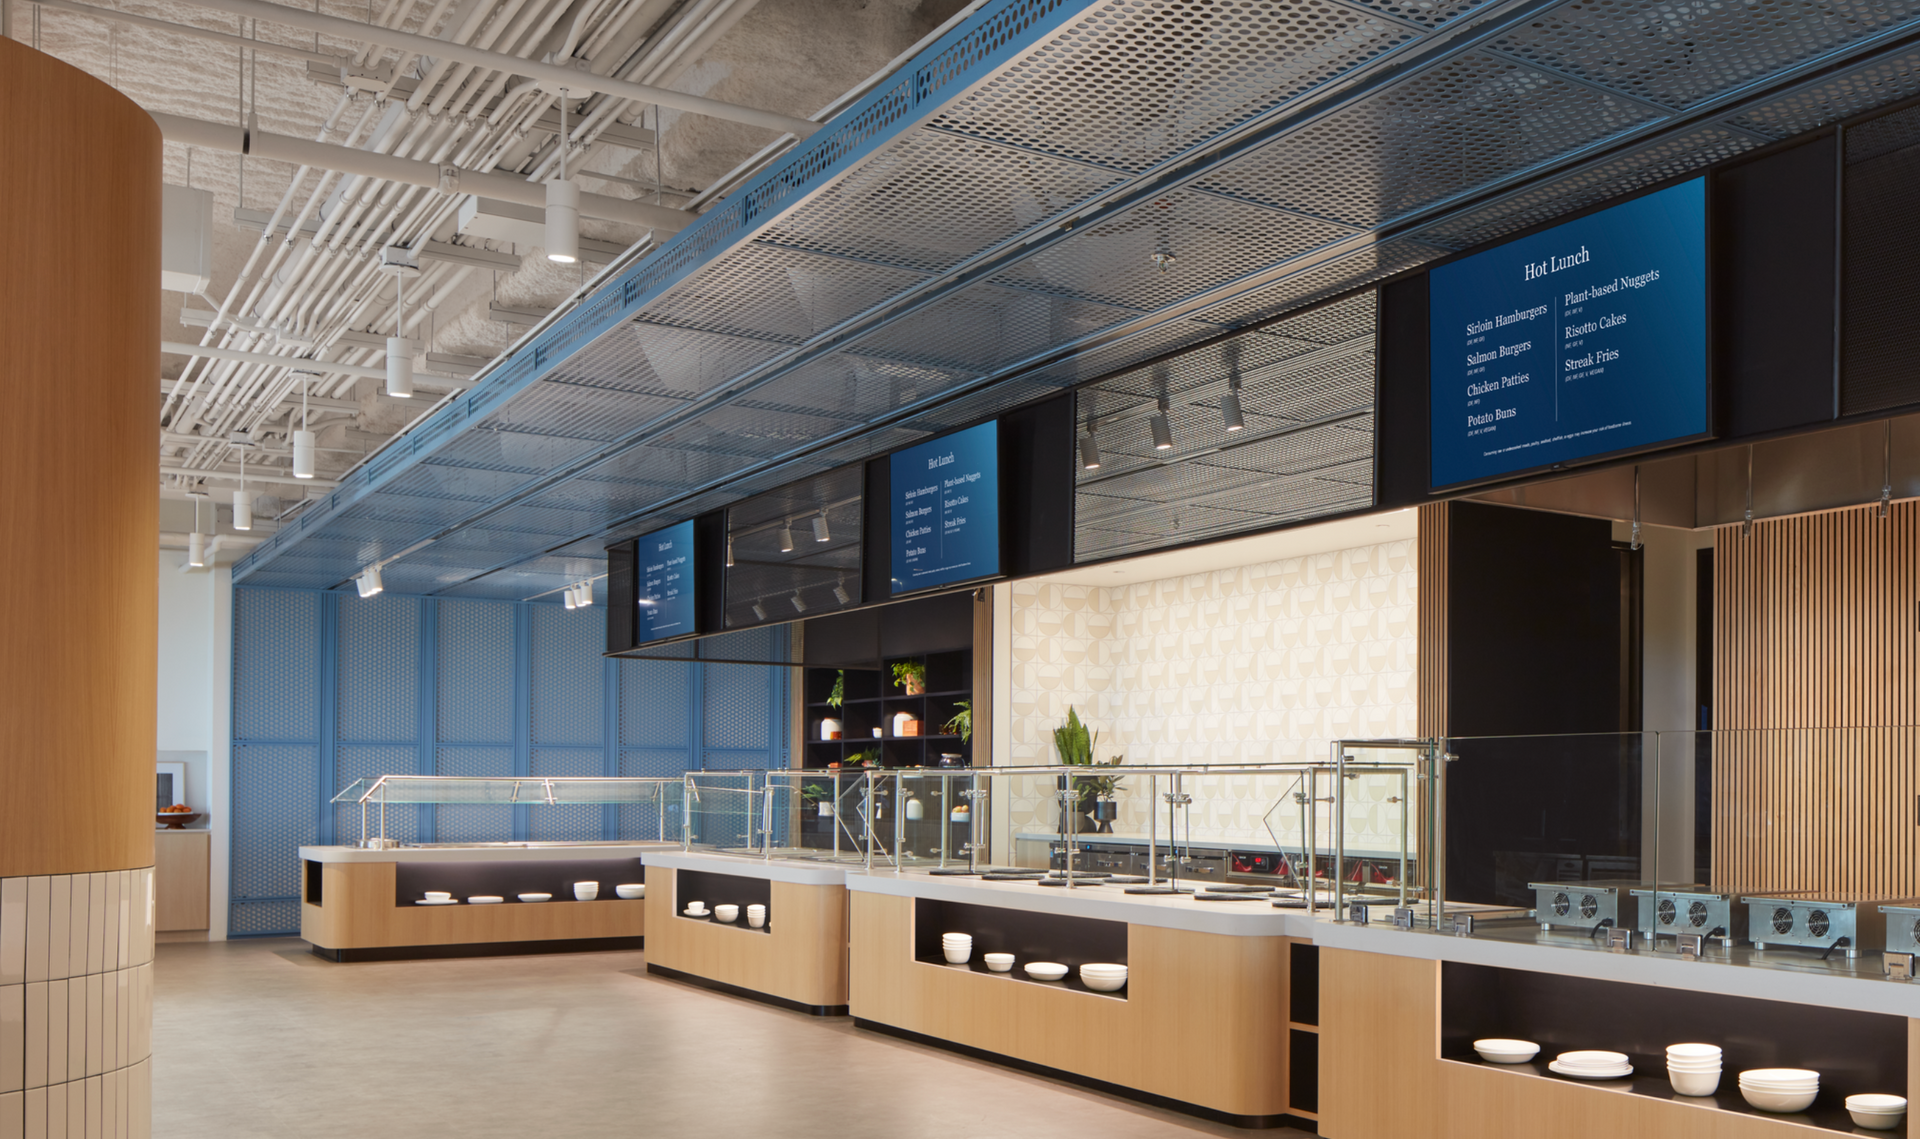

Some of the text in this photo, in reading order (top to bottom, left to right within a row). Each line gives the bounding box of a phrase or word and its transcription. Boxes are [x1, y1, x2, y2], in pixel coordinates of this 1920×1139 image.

[1525, 245, 1590, 281] Hot Lunch
[1564, 269, 1660, 306] Plant-based Nuggets
[1466, 304, 1548, 336] Sirloin Hamburgers
[1565, 313, 1627, 339] Risotto Cakes
[1466, 340, 1532, 367] Salmon Burgers
[1565, 348, 1619, 372] Streak Fries
[1467, 372, 1530, 397] Chicken Patties
[1467, 406, 1517, 427] Potato Buns
[928, 452, 954, 470] Hot Lunch
